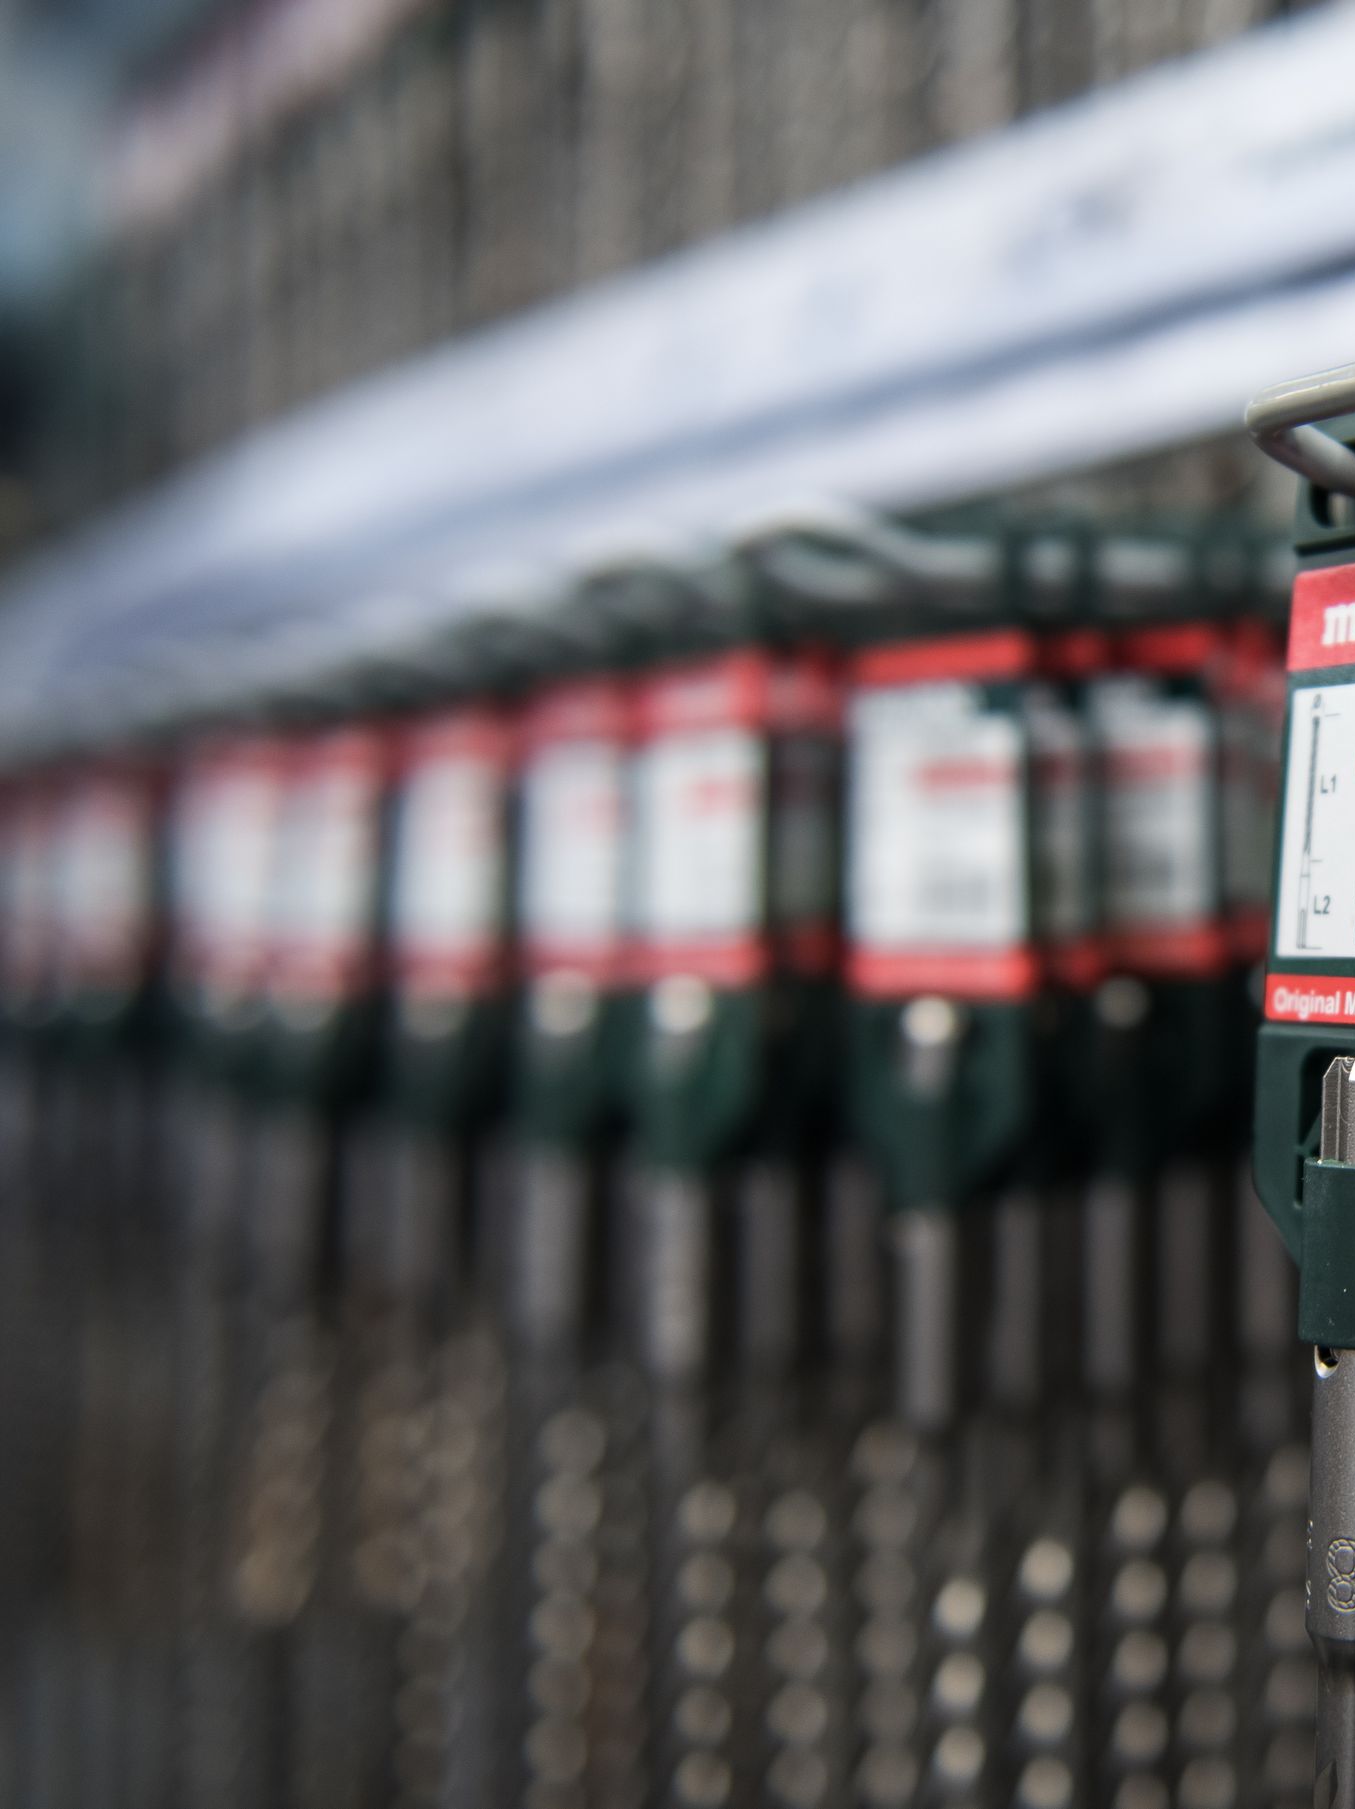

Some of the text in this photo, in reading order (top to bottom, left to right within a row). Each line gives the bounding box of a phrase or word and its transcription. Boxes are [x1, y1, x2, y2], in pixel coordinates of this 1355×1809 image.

[1320, 773, 1337, 794] L1
[1313, 895, 1331, 914] L2
[1273, 986, 1340, 1021] Original
